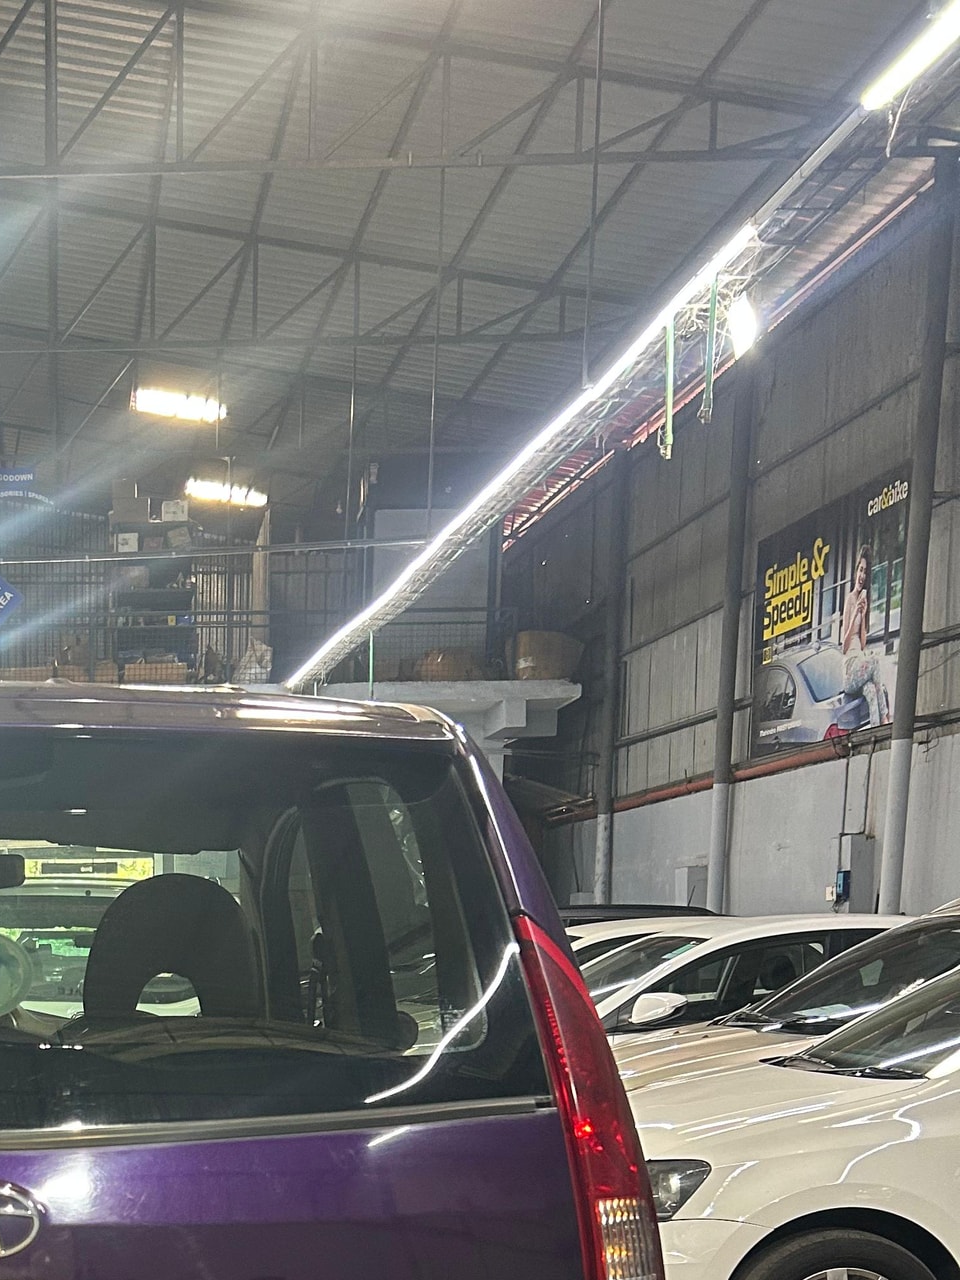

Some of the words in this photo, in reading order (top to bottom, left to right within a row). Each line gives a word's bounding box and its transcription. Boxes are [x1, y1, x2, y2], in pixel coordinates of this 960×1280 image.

[867, 480, 909, 517] car&bike
[764, 551, 809, 600] Simple
[810, 538, 830, 580] &
[763, 588, 812, 636] Speedy
